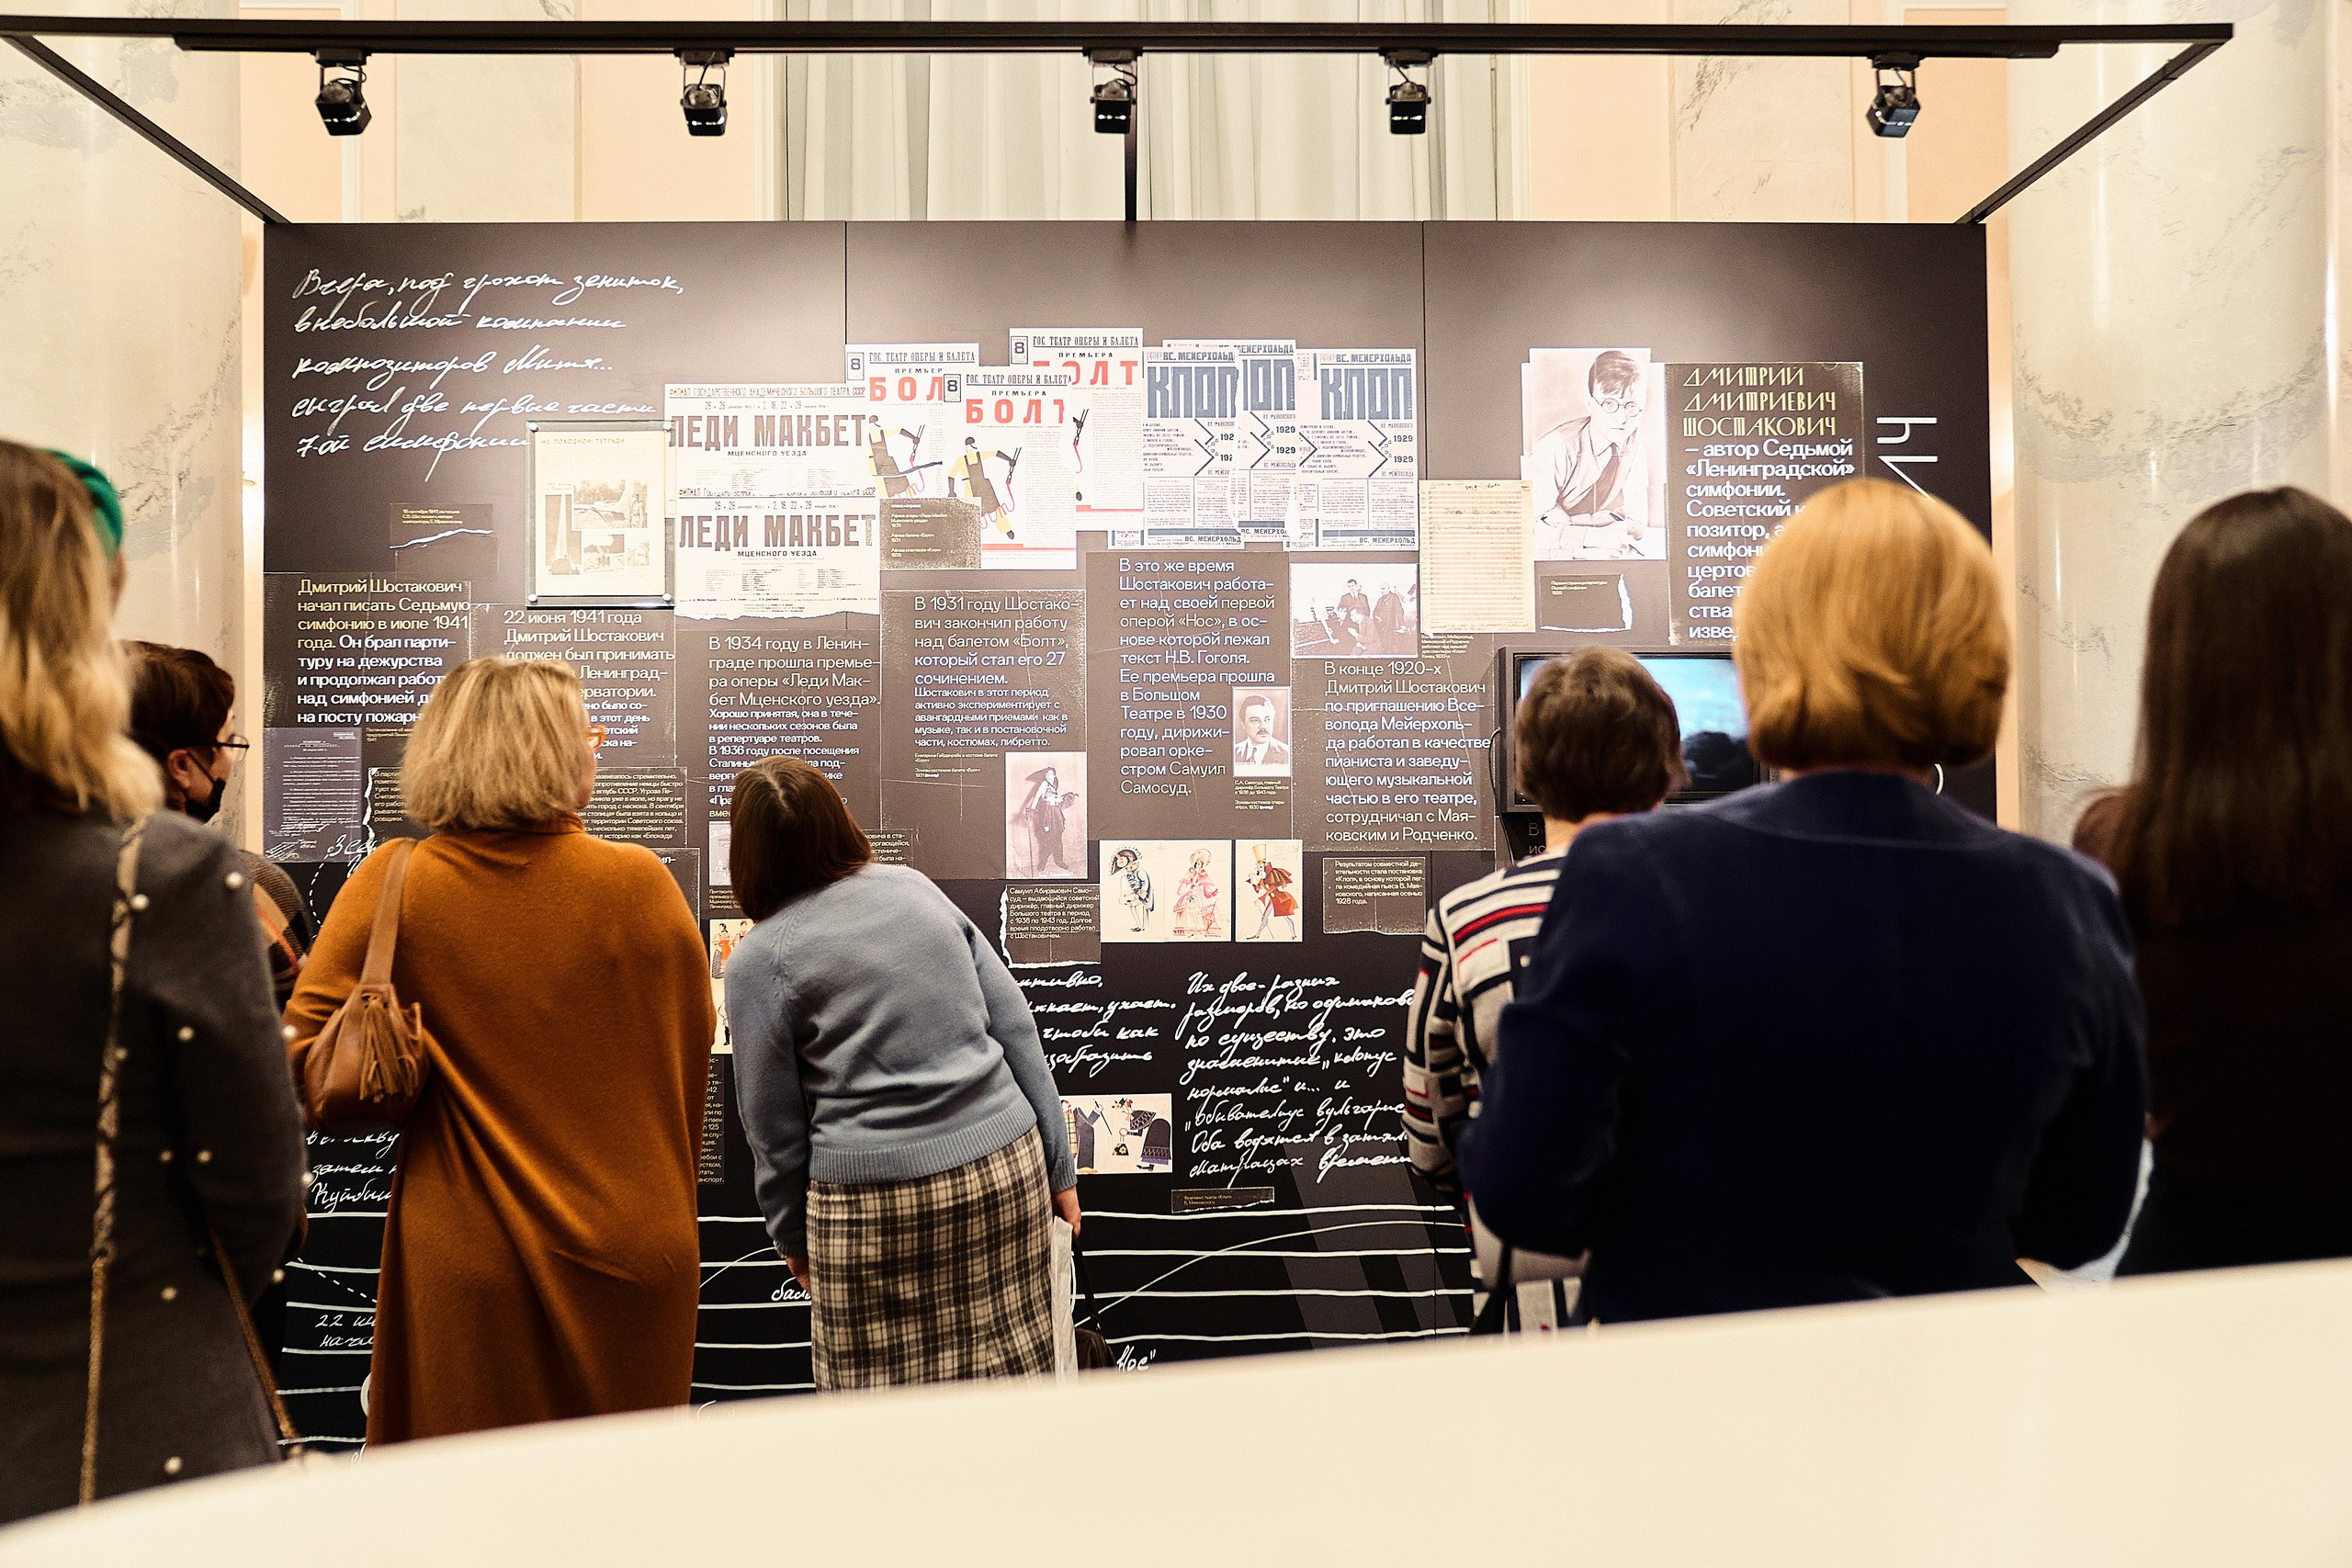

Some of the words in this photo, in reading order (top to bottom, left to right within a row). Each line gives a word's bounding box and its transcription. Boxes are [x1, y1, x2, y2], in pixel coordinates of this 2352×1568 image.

[1013, 342, 1025, 355] 8
[1049, 335, 1071, 346] ТЕАТР
[1074, 335, 1100, 346] ОПЕРЫ
[1110, 335, 1139, 346] БАЛЕТА
[1033, 360, 1138, 386] ОЛТ
[1682, 367, 1804, 387] ДМИТРИЙ
[946, 379, 958, 392] 8
[1320, 367, 1413, 421] КЛОП
[1683, 391, 1836, 412] ДМИТРИЕВИЧ
[753, 414, 866, 447] МАКБЕТ
[1683, 416, 1836, 437] ШОСТАКОВИЧ
[1394, 434, 1414, 443] 1929
[1275, 446, 1296, 455] 1929
[1702, 445, 1759, 458] автор
[1762, 438, 1853, 458] Седьмой
[1394, 455, 1414, 463] 1929
[1685, 457, 1855, 479] «Ленинградской»
[1685, 481, 1786, 501] симфонии.
[679, 514, 749, 552] ЛЕДИ
[763, 514, 876, 547] МАКБЕТ
[1119, 558, 1131, 572] В
[1134, 561, 1160, 572] это
[1163, 561, 1185, 572] же
[1188, 561, 1235, 575] время
[298, 579, 368, 596] Дмитрий
[369, 579, 464, 593] Шостакович
[298, 602, 341, 612] начал
[344, 602, 396, 613] писать
[398, 596, 471, 616] Седьмую
[914, 596, 926, 611] В
[930, 596, 964, 611] 1931
[967, 595, 1001, 614] году
[298, 619, 375, 634] симфонию
[378, 620, 388, 630] в
[390, 620, 429, 630] июле
[432, 615, 469, 630] 1941
[503, 610, 526, 624] 22
[528, 613, 566, 624] июня
[569, 609, 606, 624] 1941
[607, 614, 643, 626] года
[914, 619, 941, 629] вич
[944, 619, 1012, 629] закончил
[1014, 615, 1068, 631] работу
[503, 627, 571, 645] Дмитрий
[573, 627, 664, 642] Шостакович
[708, 636, 721, 650] В
[724, 636, 763, 650] 1934
[765, 640, 800, 653] году
[803, 640, 813, 649] в
[914, 637, 944, 650] над
[947, 633, 1010, 648] балетом
[1012, 632, 1069, 649] «Болт»,
[297, 657, 334, 671] туру
[336, 657, 356, 667] на
[357, 657, 443, 671] дежурства
[914, 651, 978, 669] который
[980, 656, 1014, 666] стал
[1017, 656, 1043, 666] его
[1046, 650, 1066, 666] 27
[1120, 654, 1162, 664] текст
[1165, 649, 1194, 664] Н.В.
[1197, 649, 1250, 664] Гоголя.
[1324, 660, 1336, 675] В
[1339, 665, 1385, 678] конце
[914, 674, 1009, 685] сочинением.
[1324, 679, 1393, 697] Дмитрий
[1396, 679, 1486, 694] Шостакович
[708, 692, 737, 706] бет
[739, 691, 822, 708] Мценского
[825, 695, 880, 708] уезда».
[914, 686, 977, 697] Шостакович
[978, 689, 985, 697] в
[986, 689, 1010, 697] этот
[1011, 687, 1049, 700] период
[1120, 705, 1173, 723] Театре
[1176, 711, 1186, 720] в
[1189, 705, 1227, 720] 1930
[717, 735, 778, 745] репертуаре
[778, 735, 823, 745] театров.
[914, 739, 946, 748] части,
[947, 739, 999, 748] костюмах,
[1000, 737, 1051, 749] либретто.
[1325, 738, 1345, 752] да
[1348, 736, 1409, 752] работал
[1424, 739, 1458, 749] в
[1424, 738, 1491, 750] качестве
[1120, 765, 1166, 778] стром
[1170, 761, 1226, 778] Самуил
[1121, 778, 1193, 796] Самосуд.
[1325, 794, 1379, 805] частью
[1382, 794, 1391, 805] в
[1394, 794, 1419, 805] его
[1421, 794, 1477, 807] театре,
[1326, 830, 1387, 842] ковским
[1390, 830, 1399, 841] и
[1402, 826, 1478, 844] Родченко.
